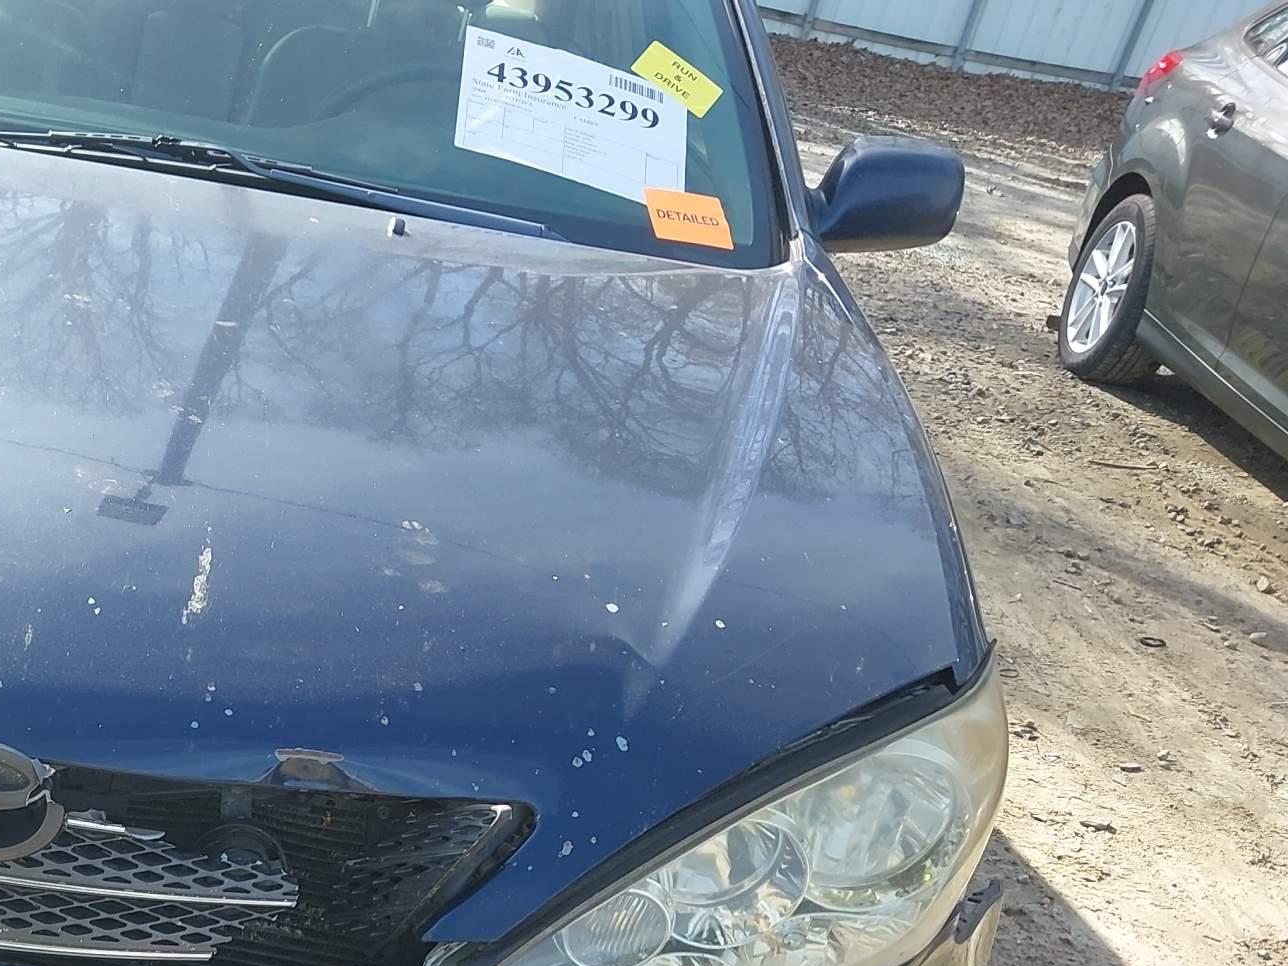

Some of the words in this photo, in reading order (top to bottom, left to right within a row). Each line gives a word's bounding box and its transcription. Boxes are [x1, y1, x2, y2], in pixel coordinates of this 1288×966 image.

[671, 60, 698, 82] RUN
[673, 74, 682, 83] &
[471, 77, 495, 90] State
[524, 91, 568, 110] Insurance
[487, 62, 660, 129] 43953299
[653, 71, 691, 101] DRIVE
[655, 207, 720, 227] DETAILED
